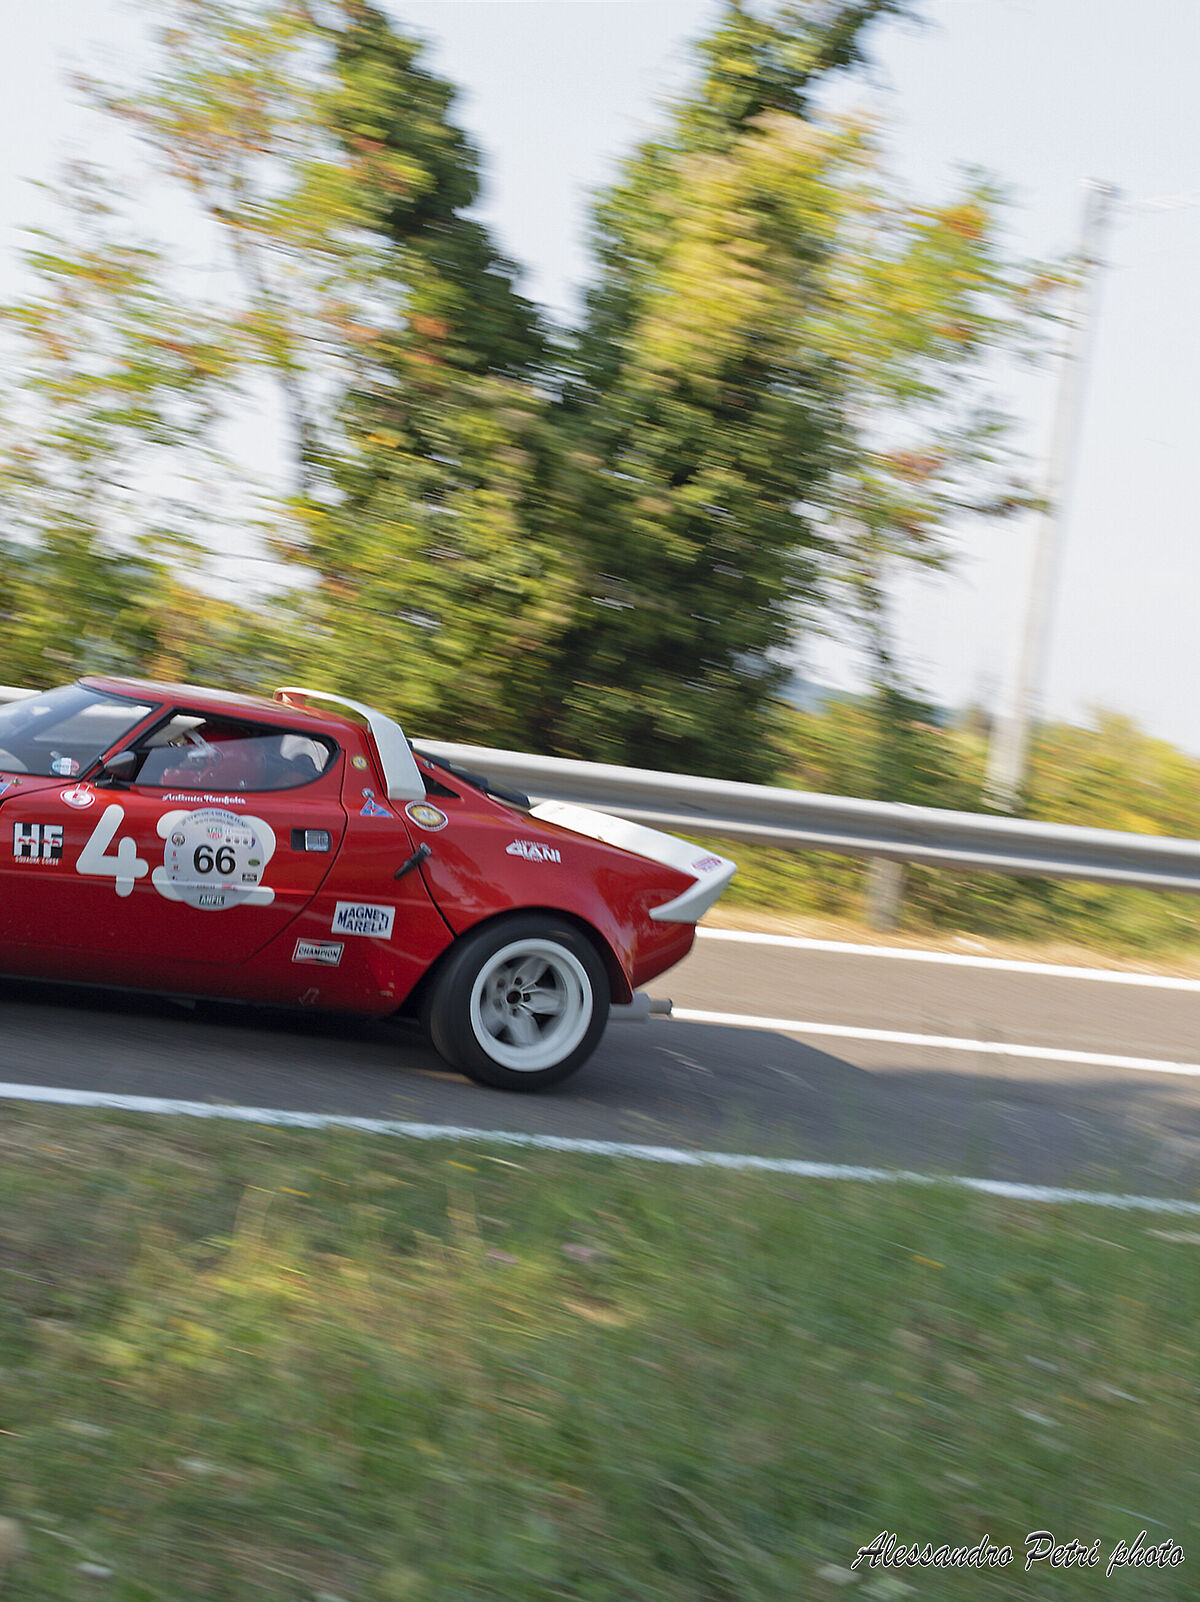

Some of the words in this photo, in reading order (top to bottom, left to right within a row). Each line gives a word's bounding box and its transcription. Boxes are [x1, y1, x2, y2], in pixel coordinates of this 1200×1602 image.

[13, 822, 63, 858] HF
[193, 844, 236, 875] 66
[298, 946, 339, 958] CHAMPION
